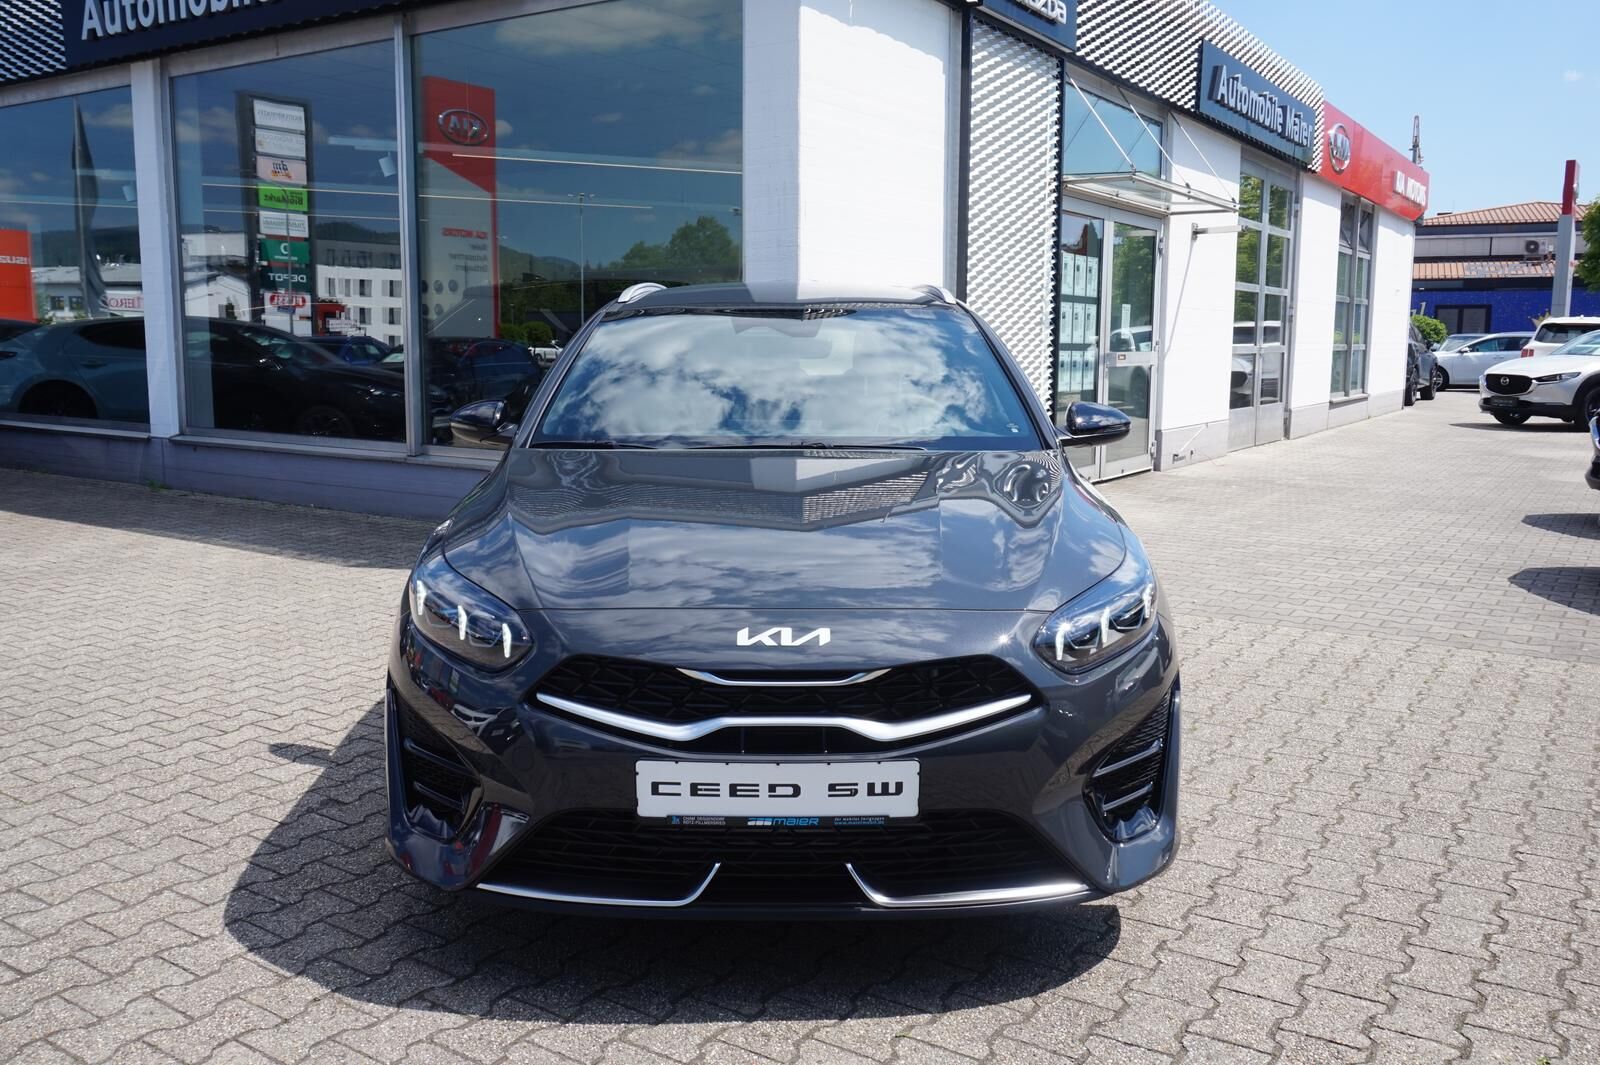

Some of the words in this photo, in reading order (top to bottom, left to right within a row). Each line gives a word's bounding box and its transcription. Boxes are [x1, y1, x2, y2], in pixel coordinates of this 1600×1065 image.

[1217, 65, 1284, 132] Automobile
[1285, 105, 1313, 147] Maier
[736, 627, 831, 646] KIA
[651, 781, 802, 798] CEED
[827, 781, 904, 798] SW
